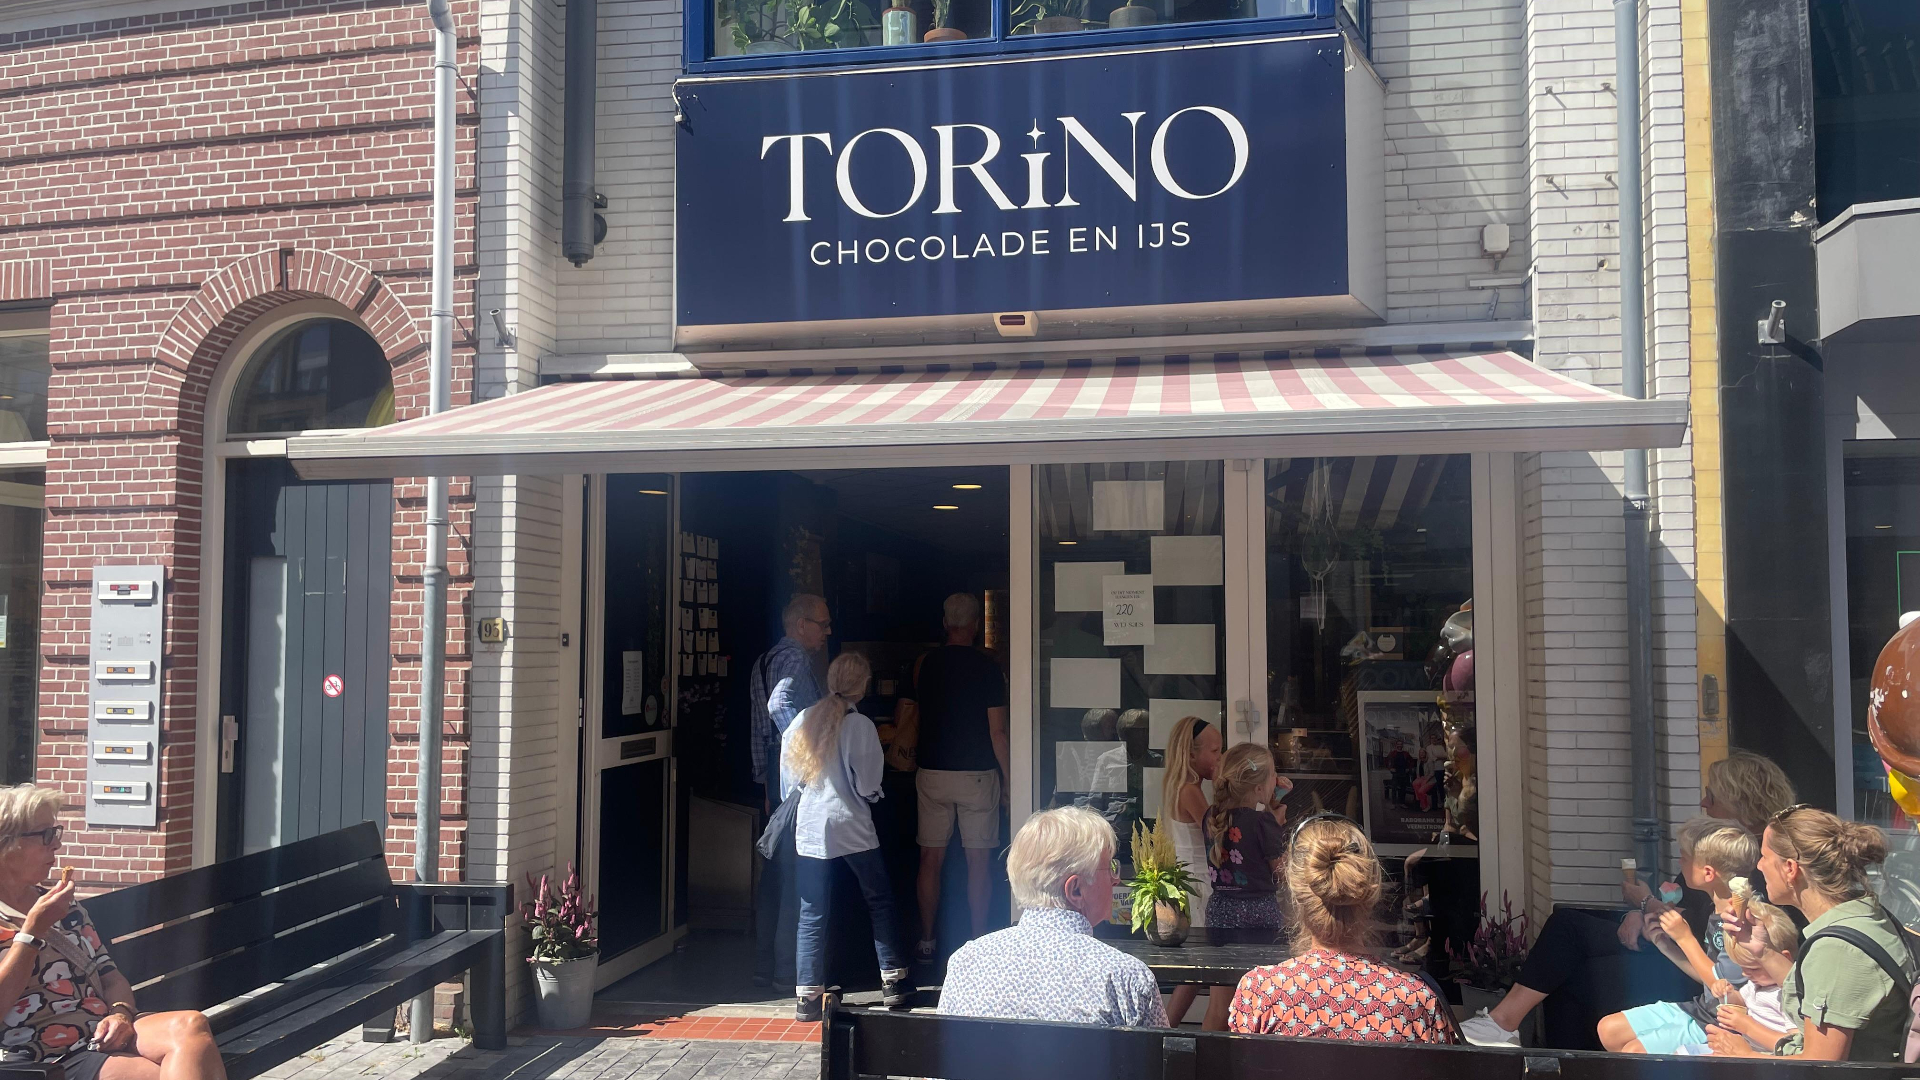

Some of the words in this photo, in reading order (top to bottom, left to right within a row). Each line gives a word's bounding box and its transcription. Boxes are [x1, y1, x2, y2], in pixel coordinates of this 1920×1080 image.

[810, 229, 1052, 266] CHOCOLADE
[1069, 225, 1118, 254] EN
[1138, 221, 1191, 249] IJS
[1115, 603, 1134, 616] 220
